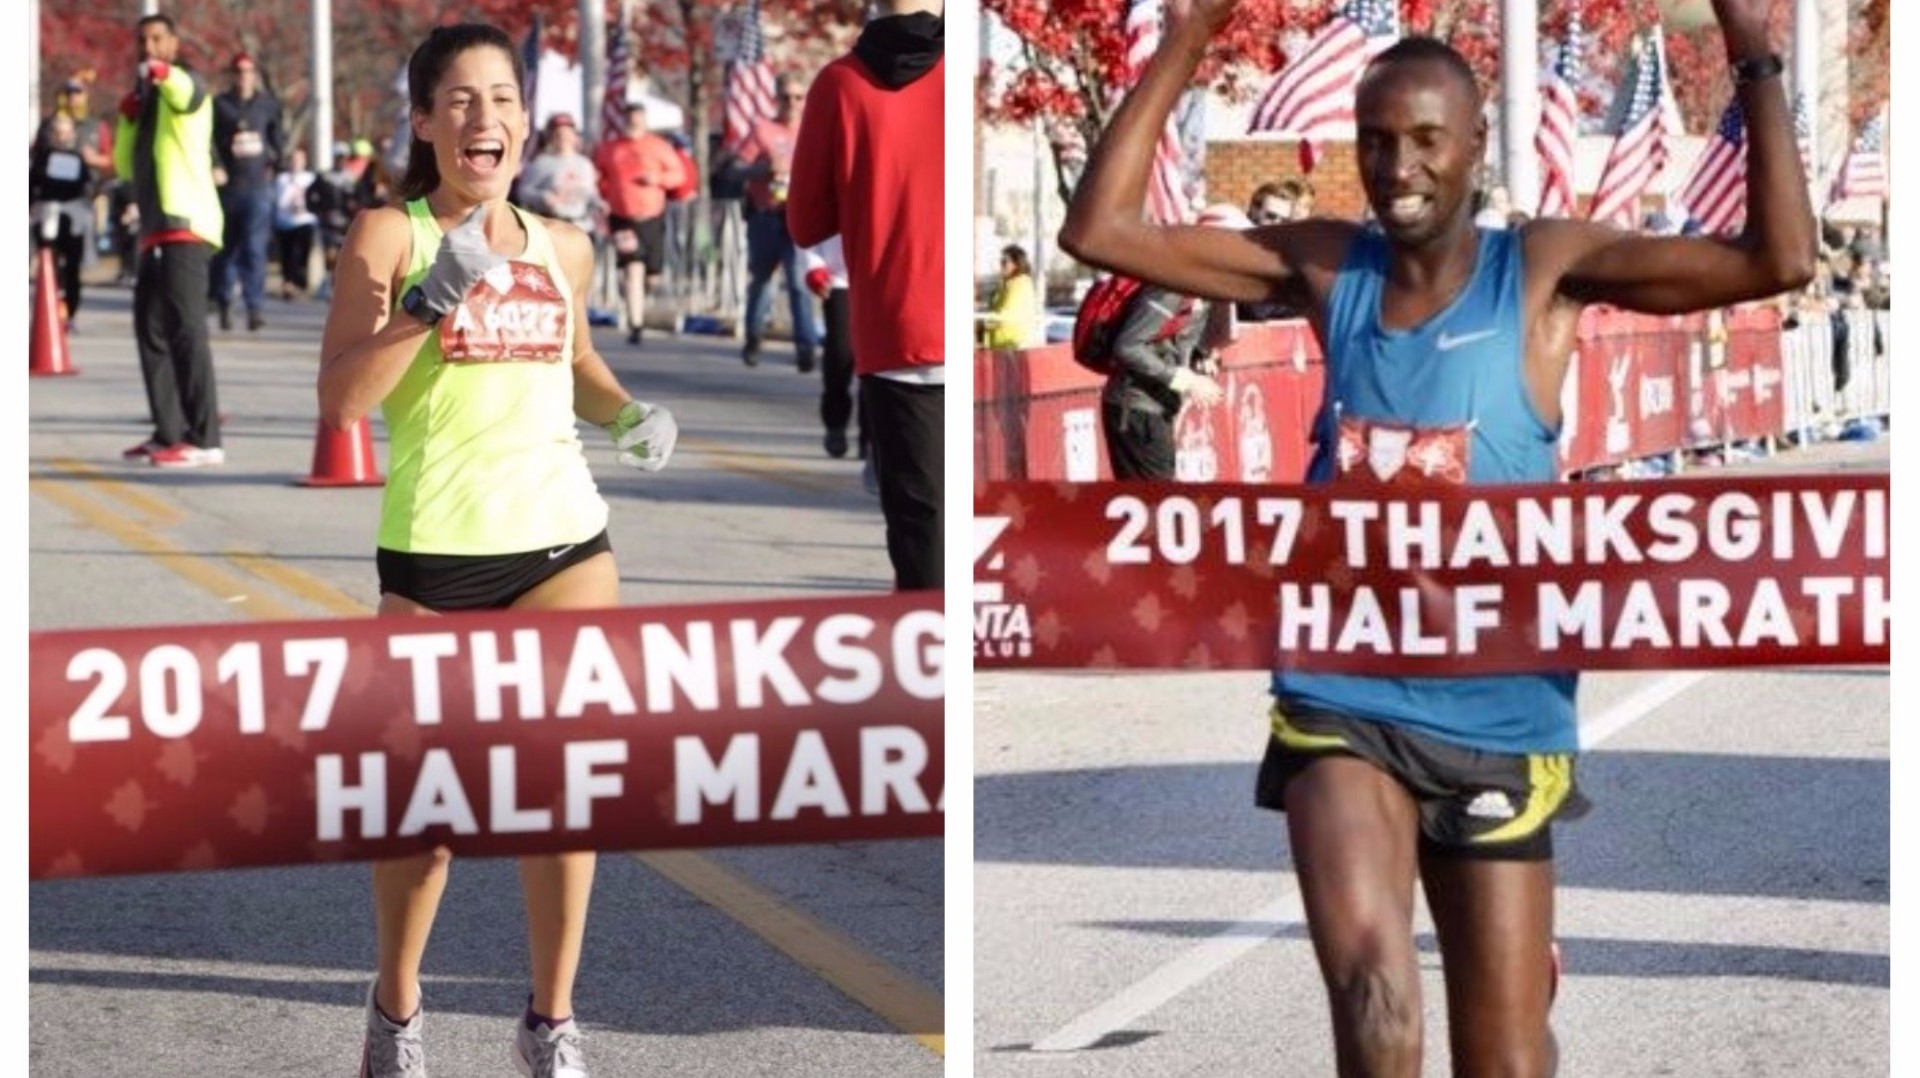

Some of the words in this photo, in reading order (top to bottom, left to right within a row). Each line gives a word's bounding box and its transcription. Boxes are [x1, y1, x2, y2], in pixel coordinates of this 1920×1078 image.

[1105, 496, 1304, 565] 2017
[1330, 489, 1888, 570] THANKSGIVI
[1279, 582, 1503, 655] HALF
[65, 637, 350, 743] 2017
[388, 610, 945, 726] THANKSG
[315, 738, 629, 841] HALF
[674, 725, 945, 826] MAR
